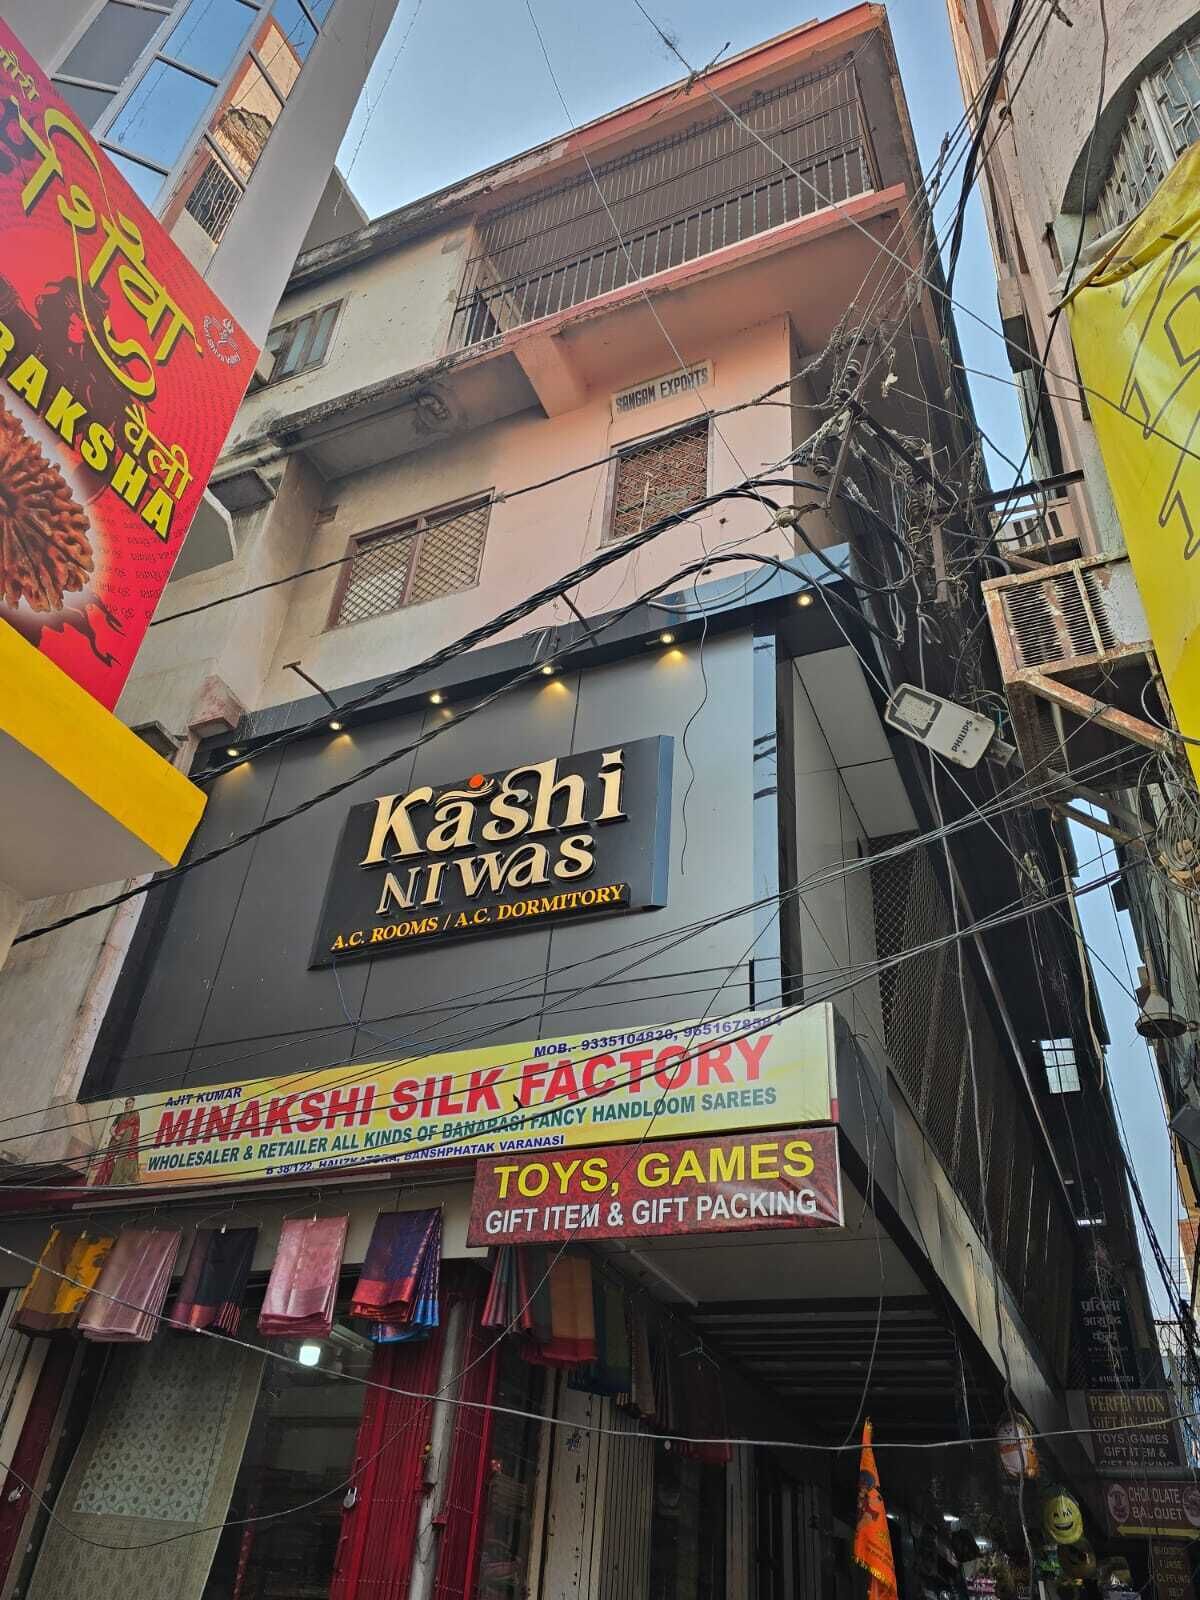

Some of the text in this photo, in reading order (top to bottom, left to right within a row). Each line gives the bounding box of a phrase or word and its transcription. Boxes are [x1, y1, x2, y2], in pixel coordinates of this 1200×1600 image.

[615, 367, 708, 414] SANGAM EXPORTS
[951, 719, 974, 753] PHILIPS
[331, 931, 365, 950] A.C.
[371, 916, 438, 943] ROOMS
[455, 908, 491, 928] A.C.
[497, 884, 625, 921] DORMITORY
[152, 1034, 773, 1150] MINAKSHI SILK FACTORY
[165, 1087, 242, 1108] AJIT KUMAR
[148, 1086, 777, 1172] WHOLESALER & RETAILER ALL KINDS OF BANARASI FANCY HANDLOOM SAREES
[404, 1142, 496, 1161] BANSHPHATAK
[499, 1135, 565, 1151] VARANASI
[493, 1140, 815, 1200] TOYS, GAMES
[485, 1189, 817, 1235] GIFT ITEM & GIFT PACKING
[1104, 1446, 1127, 1457] GIFT
[1130, 1433, 1169, 1445] GAMES
